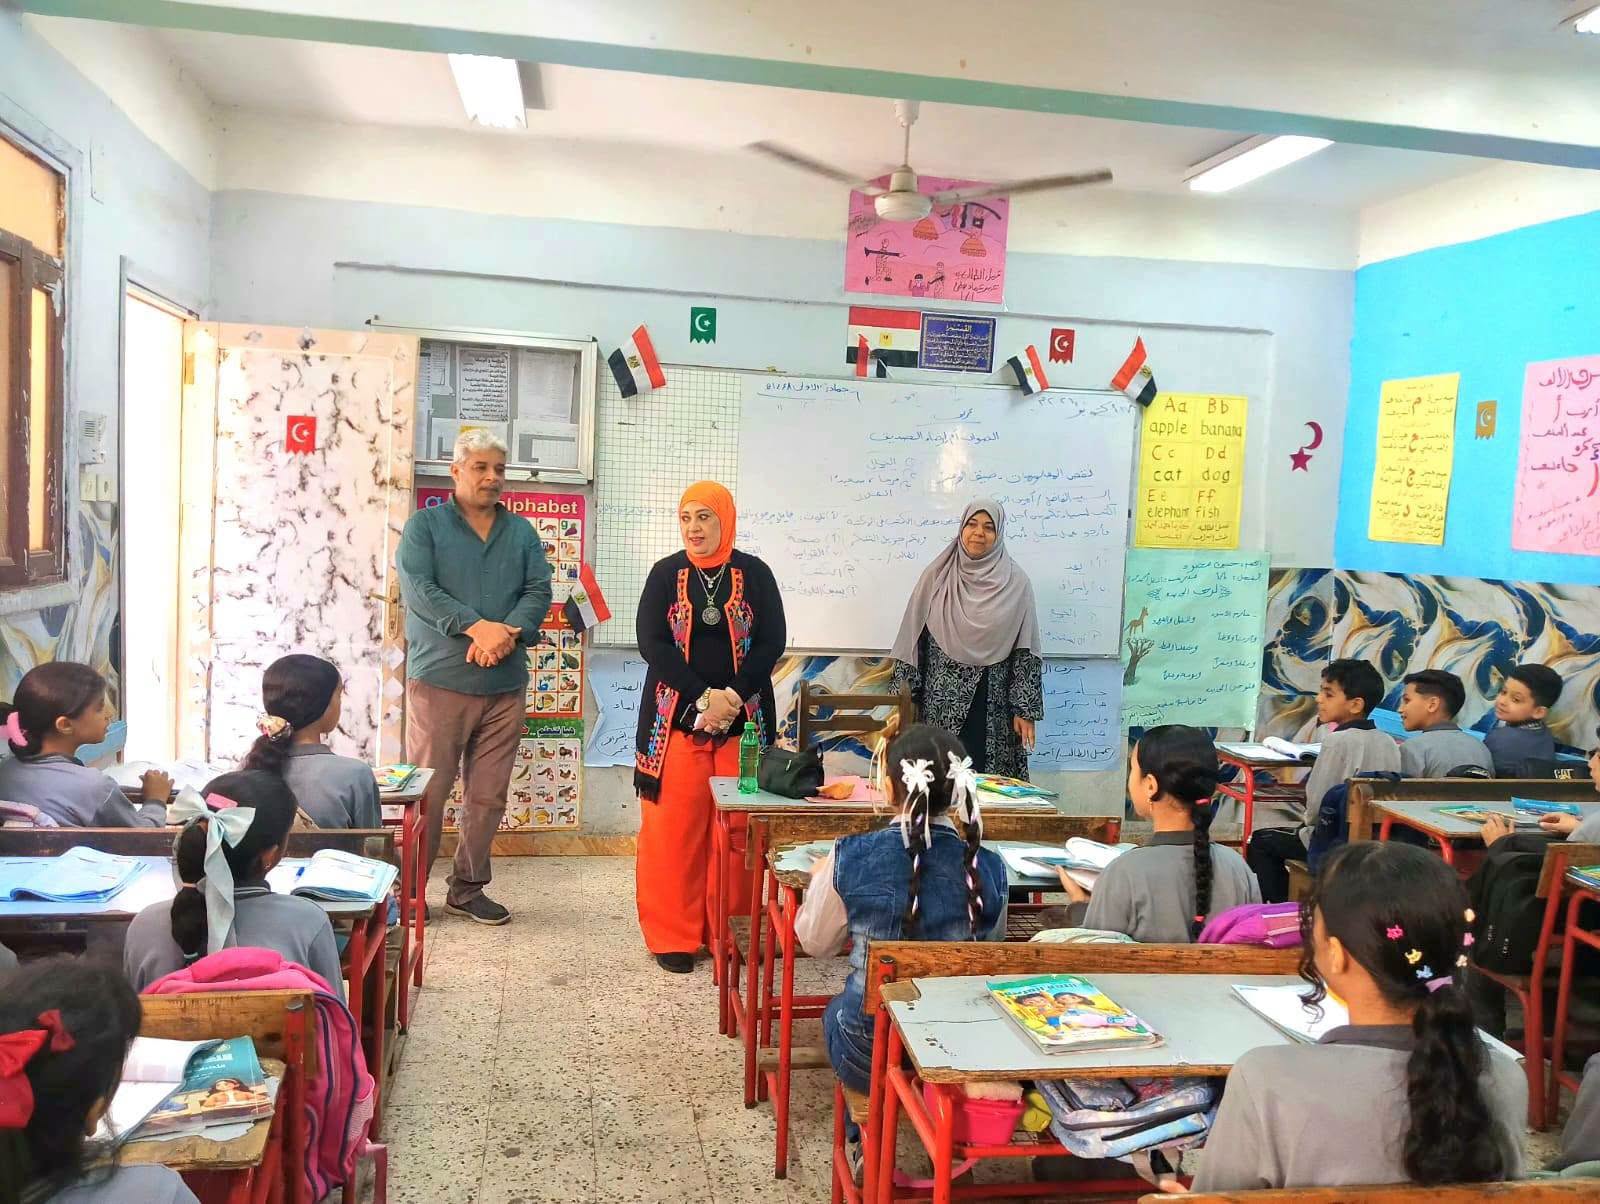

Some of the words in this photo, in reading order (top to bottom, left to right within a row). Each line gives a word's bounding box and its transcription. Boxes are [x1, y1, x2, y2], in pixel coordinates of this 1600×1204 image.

[1149, 420, 1188, 436] apple
[1200, 420, 1242, 437] banana
[1153, 468, 1182, 482] cat
[1201, 468, 1230, 484] dog
[1146, 504, 1190, 518] elephant
[1195, 504, 1221, 518] fish
[560, 519, 568, 530] g
[560, 541, 567, 550] n
[560, 562, 567, 571] u
[1090, 747, 1112, 760] عمل
[1554, 768, 1575, 780] CAT
